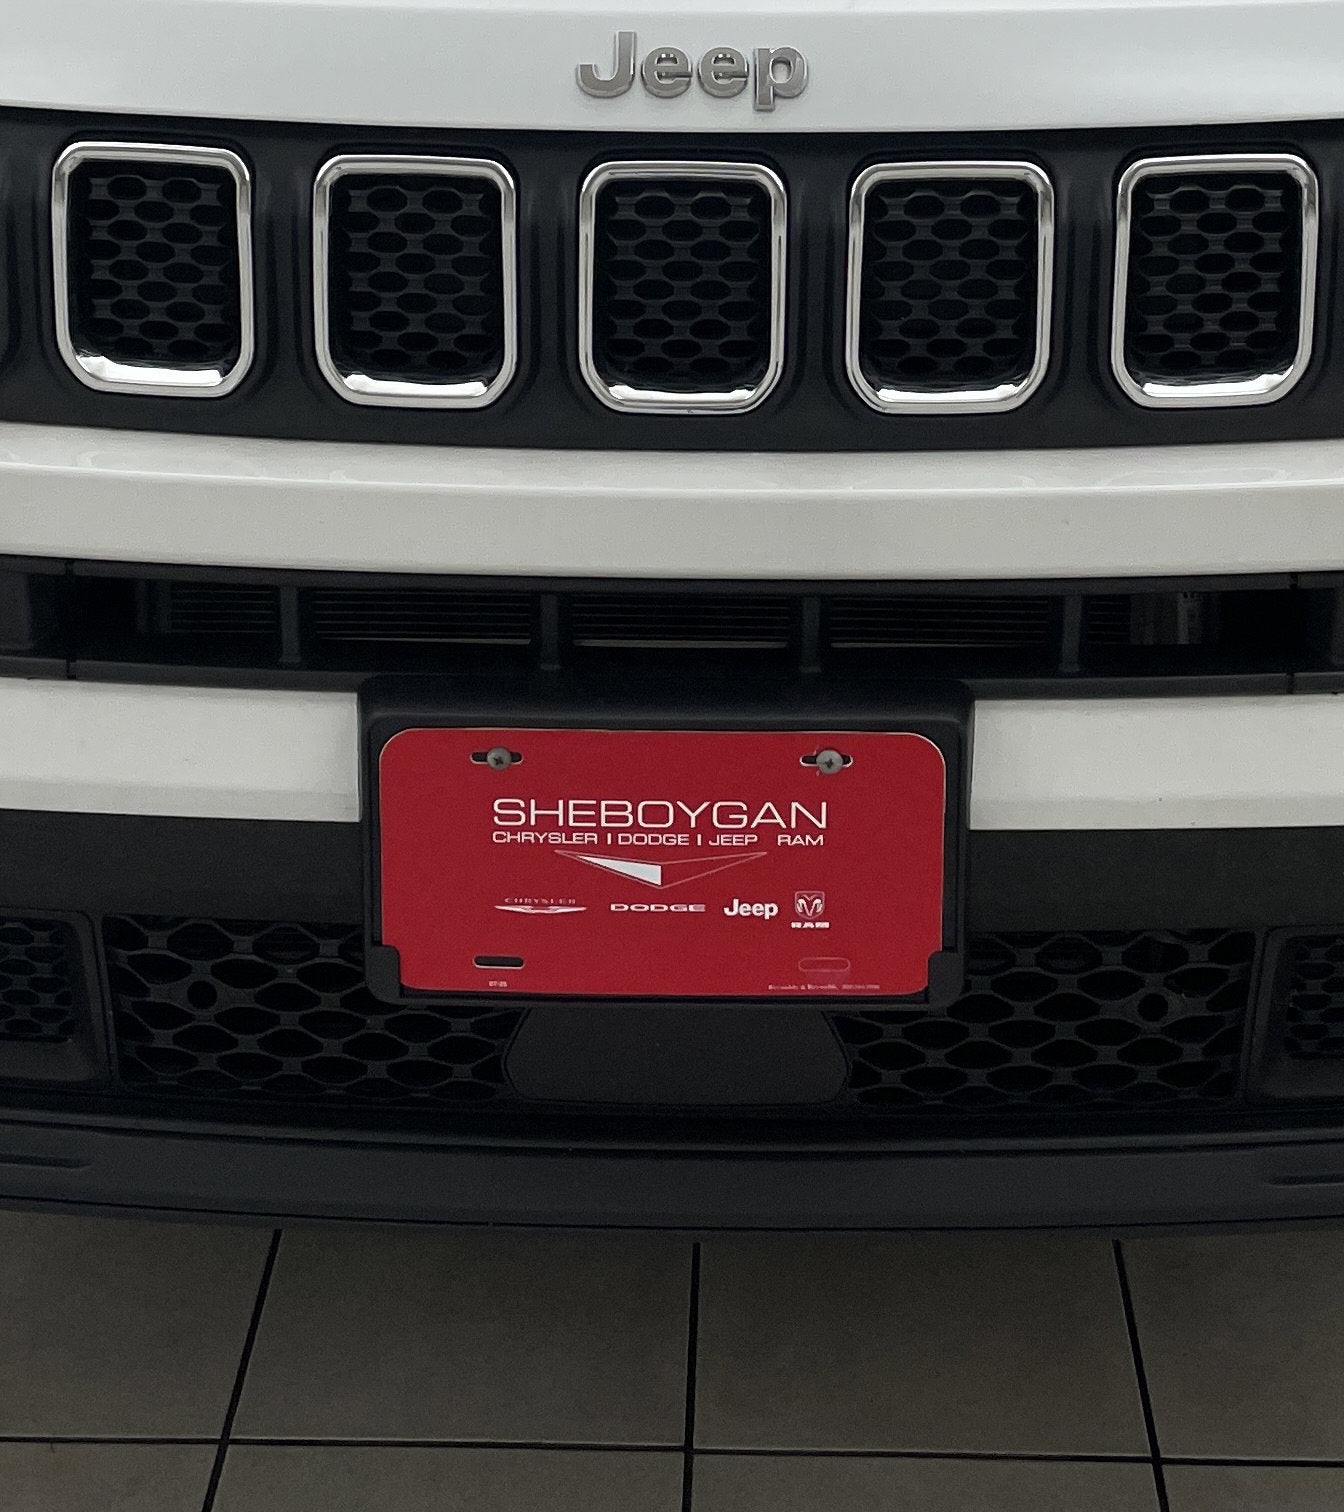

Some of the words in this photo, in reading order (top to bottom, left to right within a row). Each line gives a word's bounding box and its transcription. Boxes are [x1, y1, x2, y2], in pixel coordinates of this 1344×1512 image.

[576, 31, 809, 112] Jeep
[492, 798, 827, 830] SHEBOYGAN
[492, 831, 598, 845] CHRYSLER
[617, 833, 690, 846] DODGE
[708, 834, 758, 846] JEEP
[777, 834, 824, 847] RAM
[610, 903, 706, 913] DODGE
[723, 898, 779, 920] Jeep
